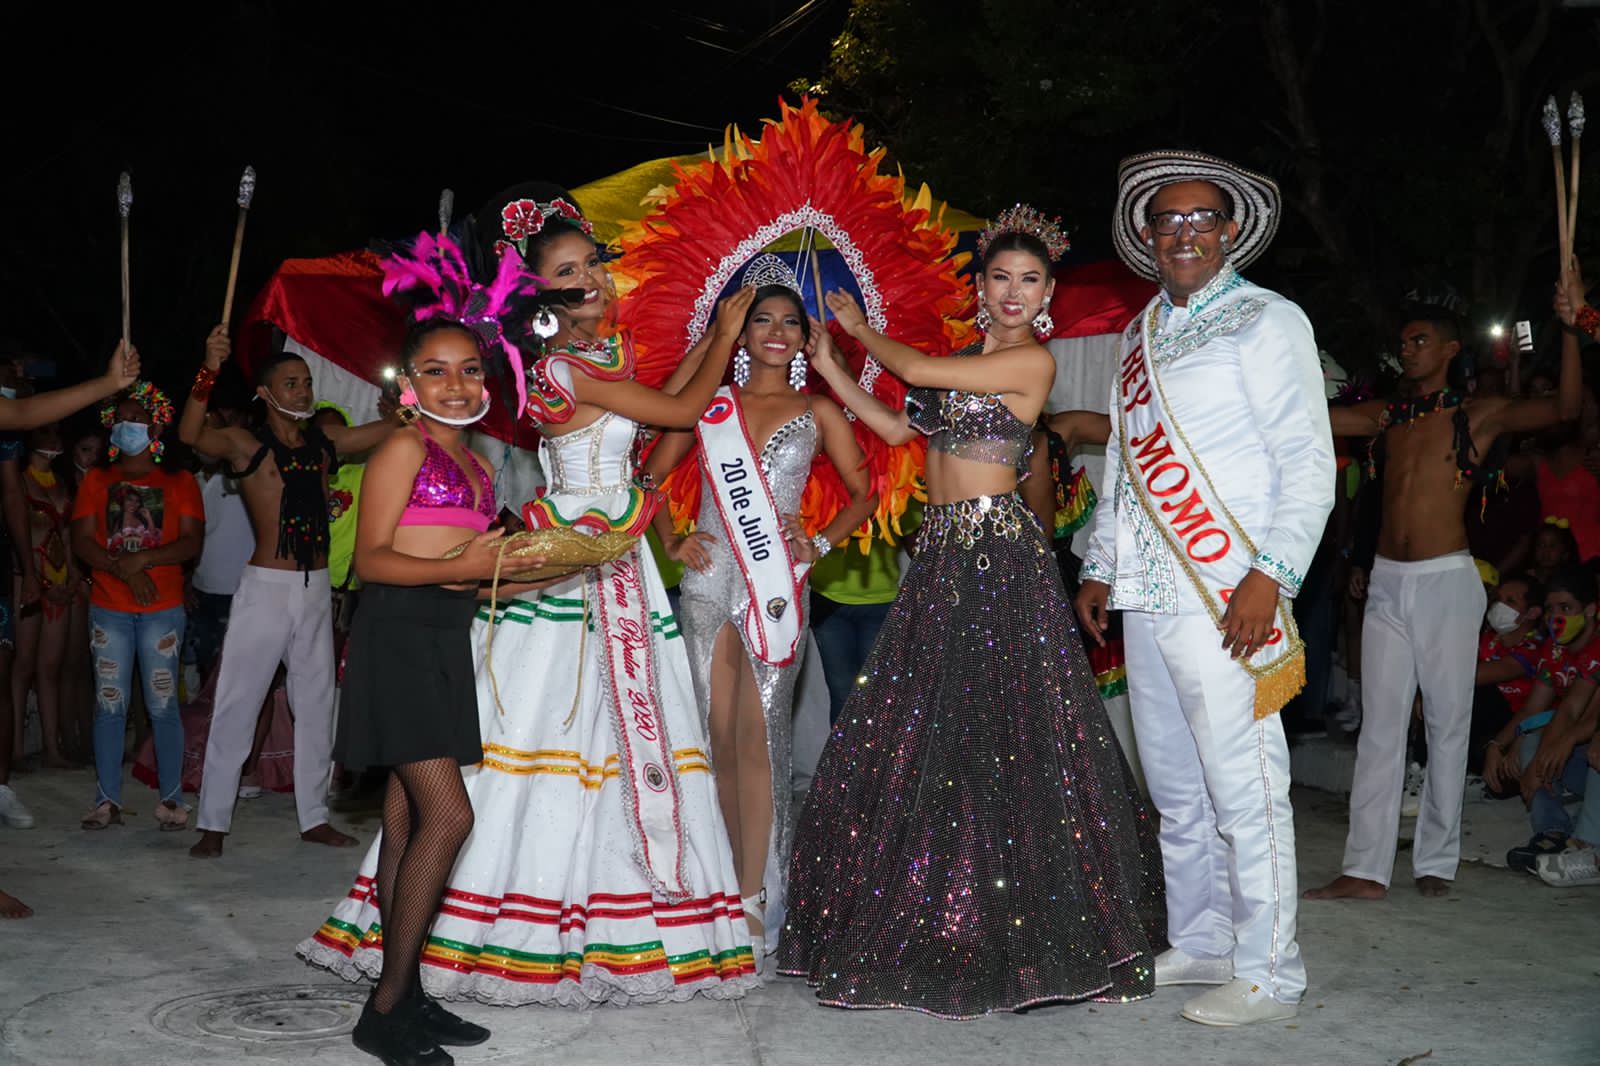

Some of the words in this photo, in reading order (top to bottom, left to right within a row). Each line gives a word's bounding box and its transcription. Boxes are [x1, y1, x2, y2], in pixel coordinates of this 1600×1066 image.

[1121, 342, 1152, 413] REY
[720, 457, 748, 484] 20
[1130, 421, 1231, 563] MOMO
[729, 486, 753, 511] de
[738, 514, 771, 562] Julio
[608, 559, 641, 608] Reina
[612, 617, 646, 680] Popular
[627, 688, 657, 741] 2020
